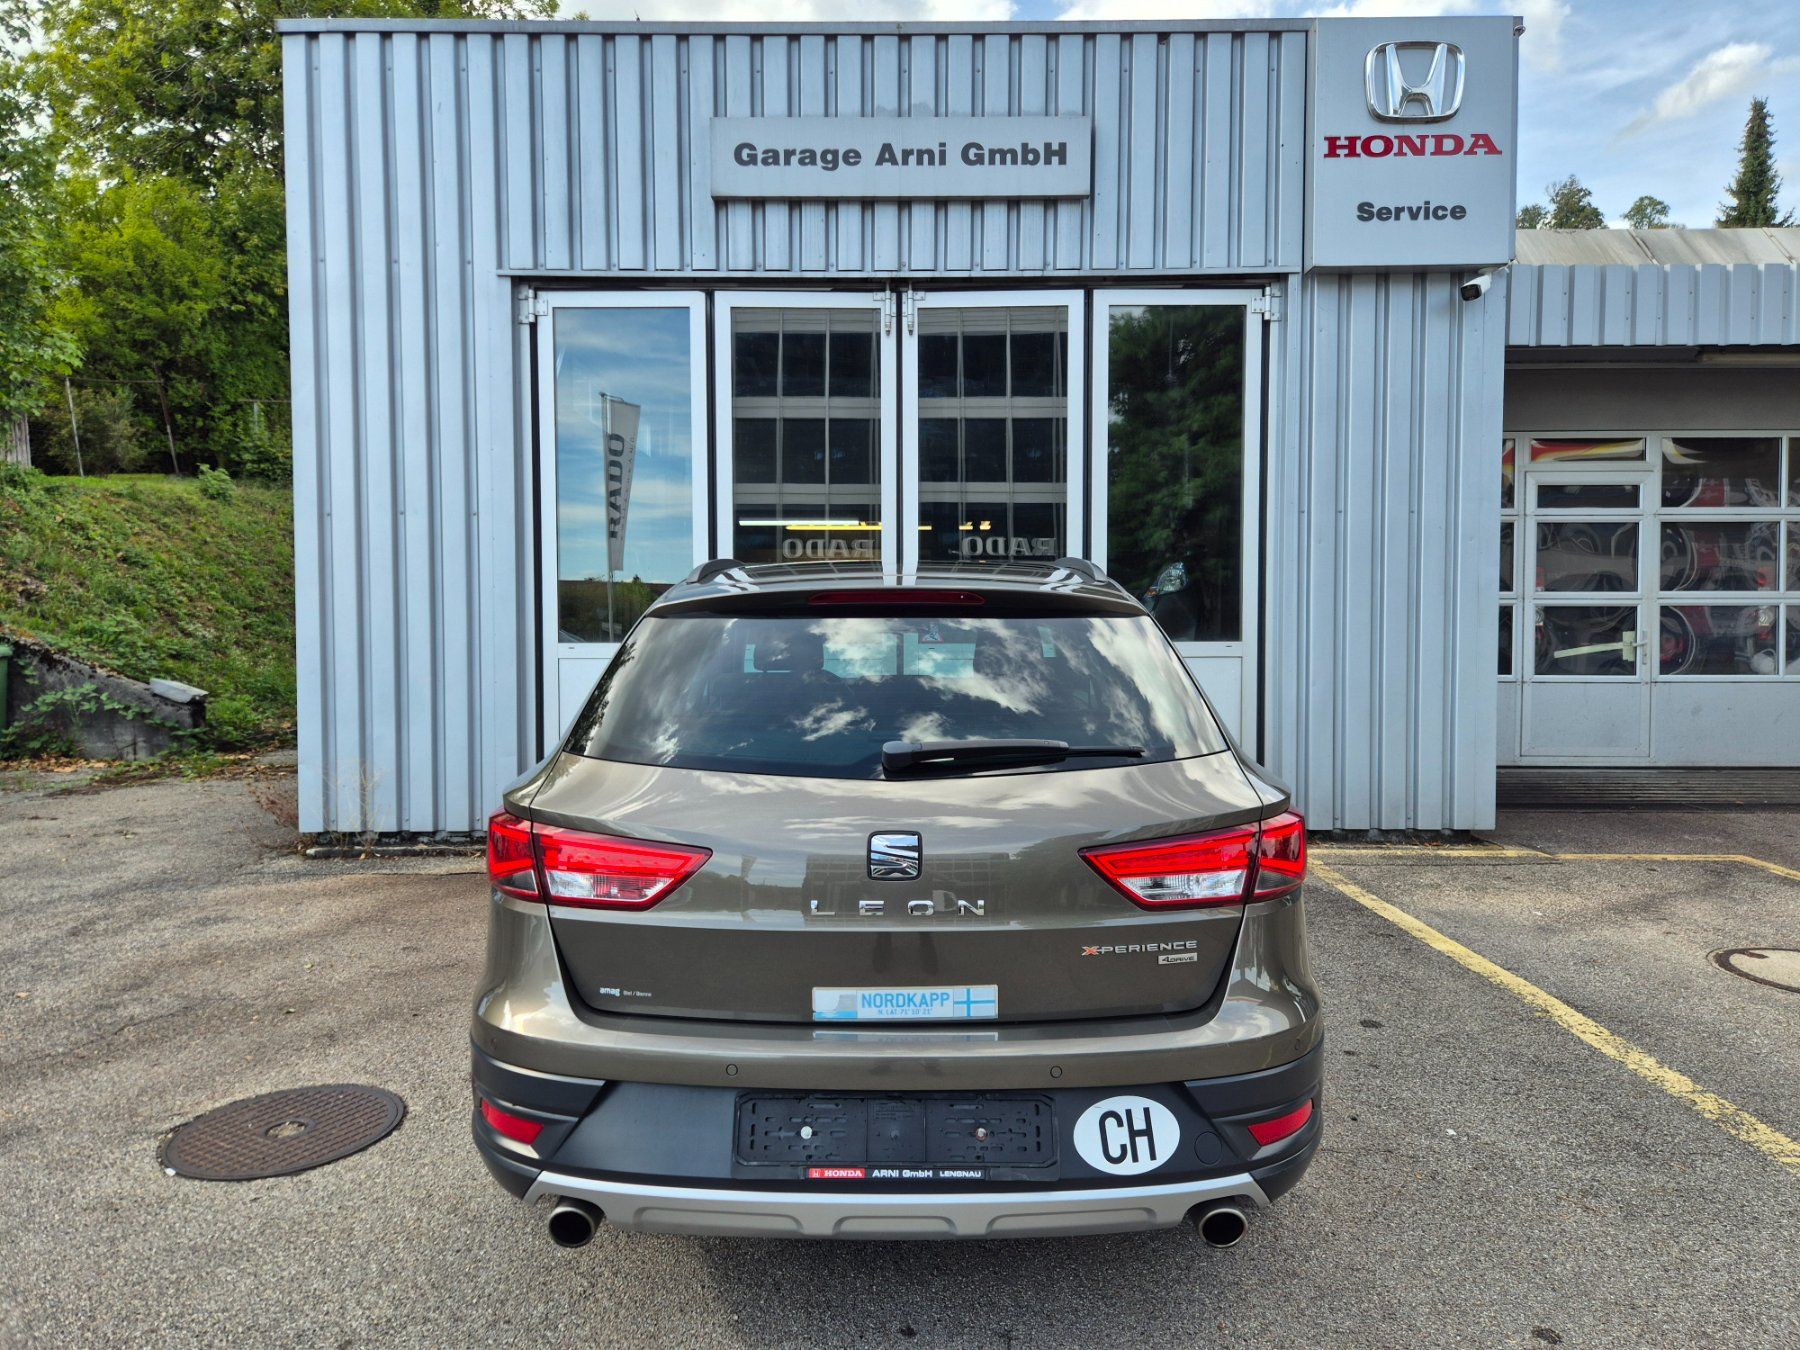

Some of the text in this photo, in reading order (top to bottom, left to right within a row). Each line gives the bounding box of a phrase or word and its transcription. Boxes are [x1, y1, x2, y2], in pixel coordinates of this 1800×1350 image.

[733, 142, 1068, 172] Garage Arni GmbH
[1323, 133, 1503, 159] HONDA
[1356, 200, 1467, 222] Service
[608, 432, 625, 539] RADO
[810, 900, 985, 916] LEON
[599, 987, 620, 997] amag
[861, 992, 950, 1008] NORDKAPP
[1098, 1106, 1157, 1165] CH
[824, 1169, 862, 1177] HONDA
[872, 1169, 899, 1178] ARNI
[902, 1169, 933, 1178] GmbH
